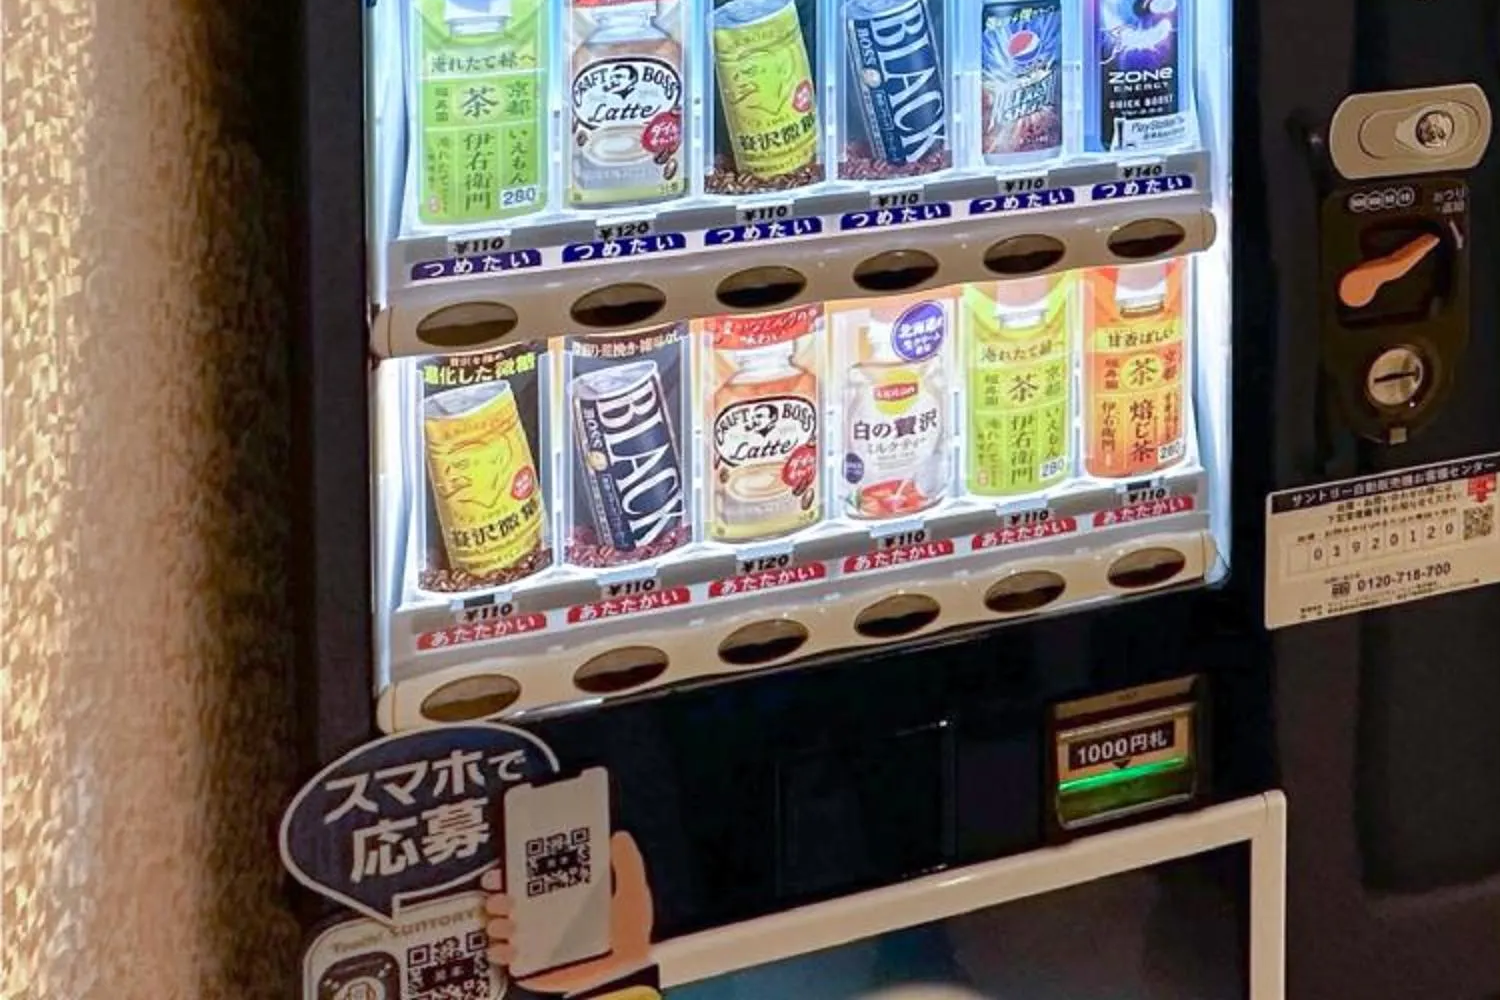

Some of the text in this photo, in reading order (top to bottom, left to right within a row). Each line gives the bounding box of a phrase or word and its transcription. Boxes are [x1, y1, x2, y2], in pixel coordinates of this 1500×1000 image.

[871, 2, 947, 164] BLACK
[1114, 81, 1169, 94] ENERGY
[462, 87, 498, 118] 茶
[588, 103, 662, 123] Latte
[463, 131, 494, 211] 伊右衛門
[1122, 165, 1163, 178] ¥140
[1005, 178, 1045, 192] ¥110
[1101, 177, 1184, 197] つめたい
[503, 187, 538, 206] 280
[877, 193, 919, 206] ¥110
[979, 189, 1066, 211] つめたい
[743, 206, 788, 220] ¥110
[851, 205, 942, 227] つめたい
[599, 221, 650, 239] ¥120
[716, 219, 812, 243] つめたい
[454, 239, 504, 254] ¥110
[573, 235, 675, 258] つめたい
[422, 254, 531, 277] つめたい
[1129, 357, 1158, 387] 茶
[875, 383, 918, 400] Lipton
[1008, 374, 1038, 402] 茶
[853, 409, 938, 441] 白の贅沢
[729, 440, 799, 461] Latte
[595, 379, 687, 548] BLACK
[1041, 459, 1065, 478] 280
[1129, 488, 1166, 503] ¥110
[1011, 509, 1050, 523] ¥110
[1102, 498, 1186, 524] あたたかい
[884, 530, 925, 547] ¥110
[981, 519, 1068, 547] あたたかい
[741, 555, 789, 572] ¥120
[853, 542, 947, 570] あたたかい
[607, 580, 655, 596] ¥110
[720, 565, 816, 595] あたたかい
[464, 603, 513, 621] ¥110
[578, 588, 680, 620] あたたかい
[430, 614, 537, 648] あたたかい
[1077, 729, 1168, 765] 1000円札
[325, 748, 525, 825] スマホで
[349, 798, 490, 883] 応募
